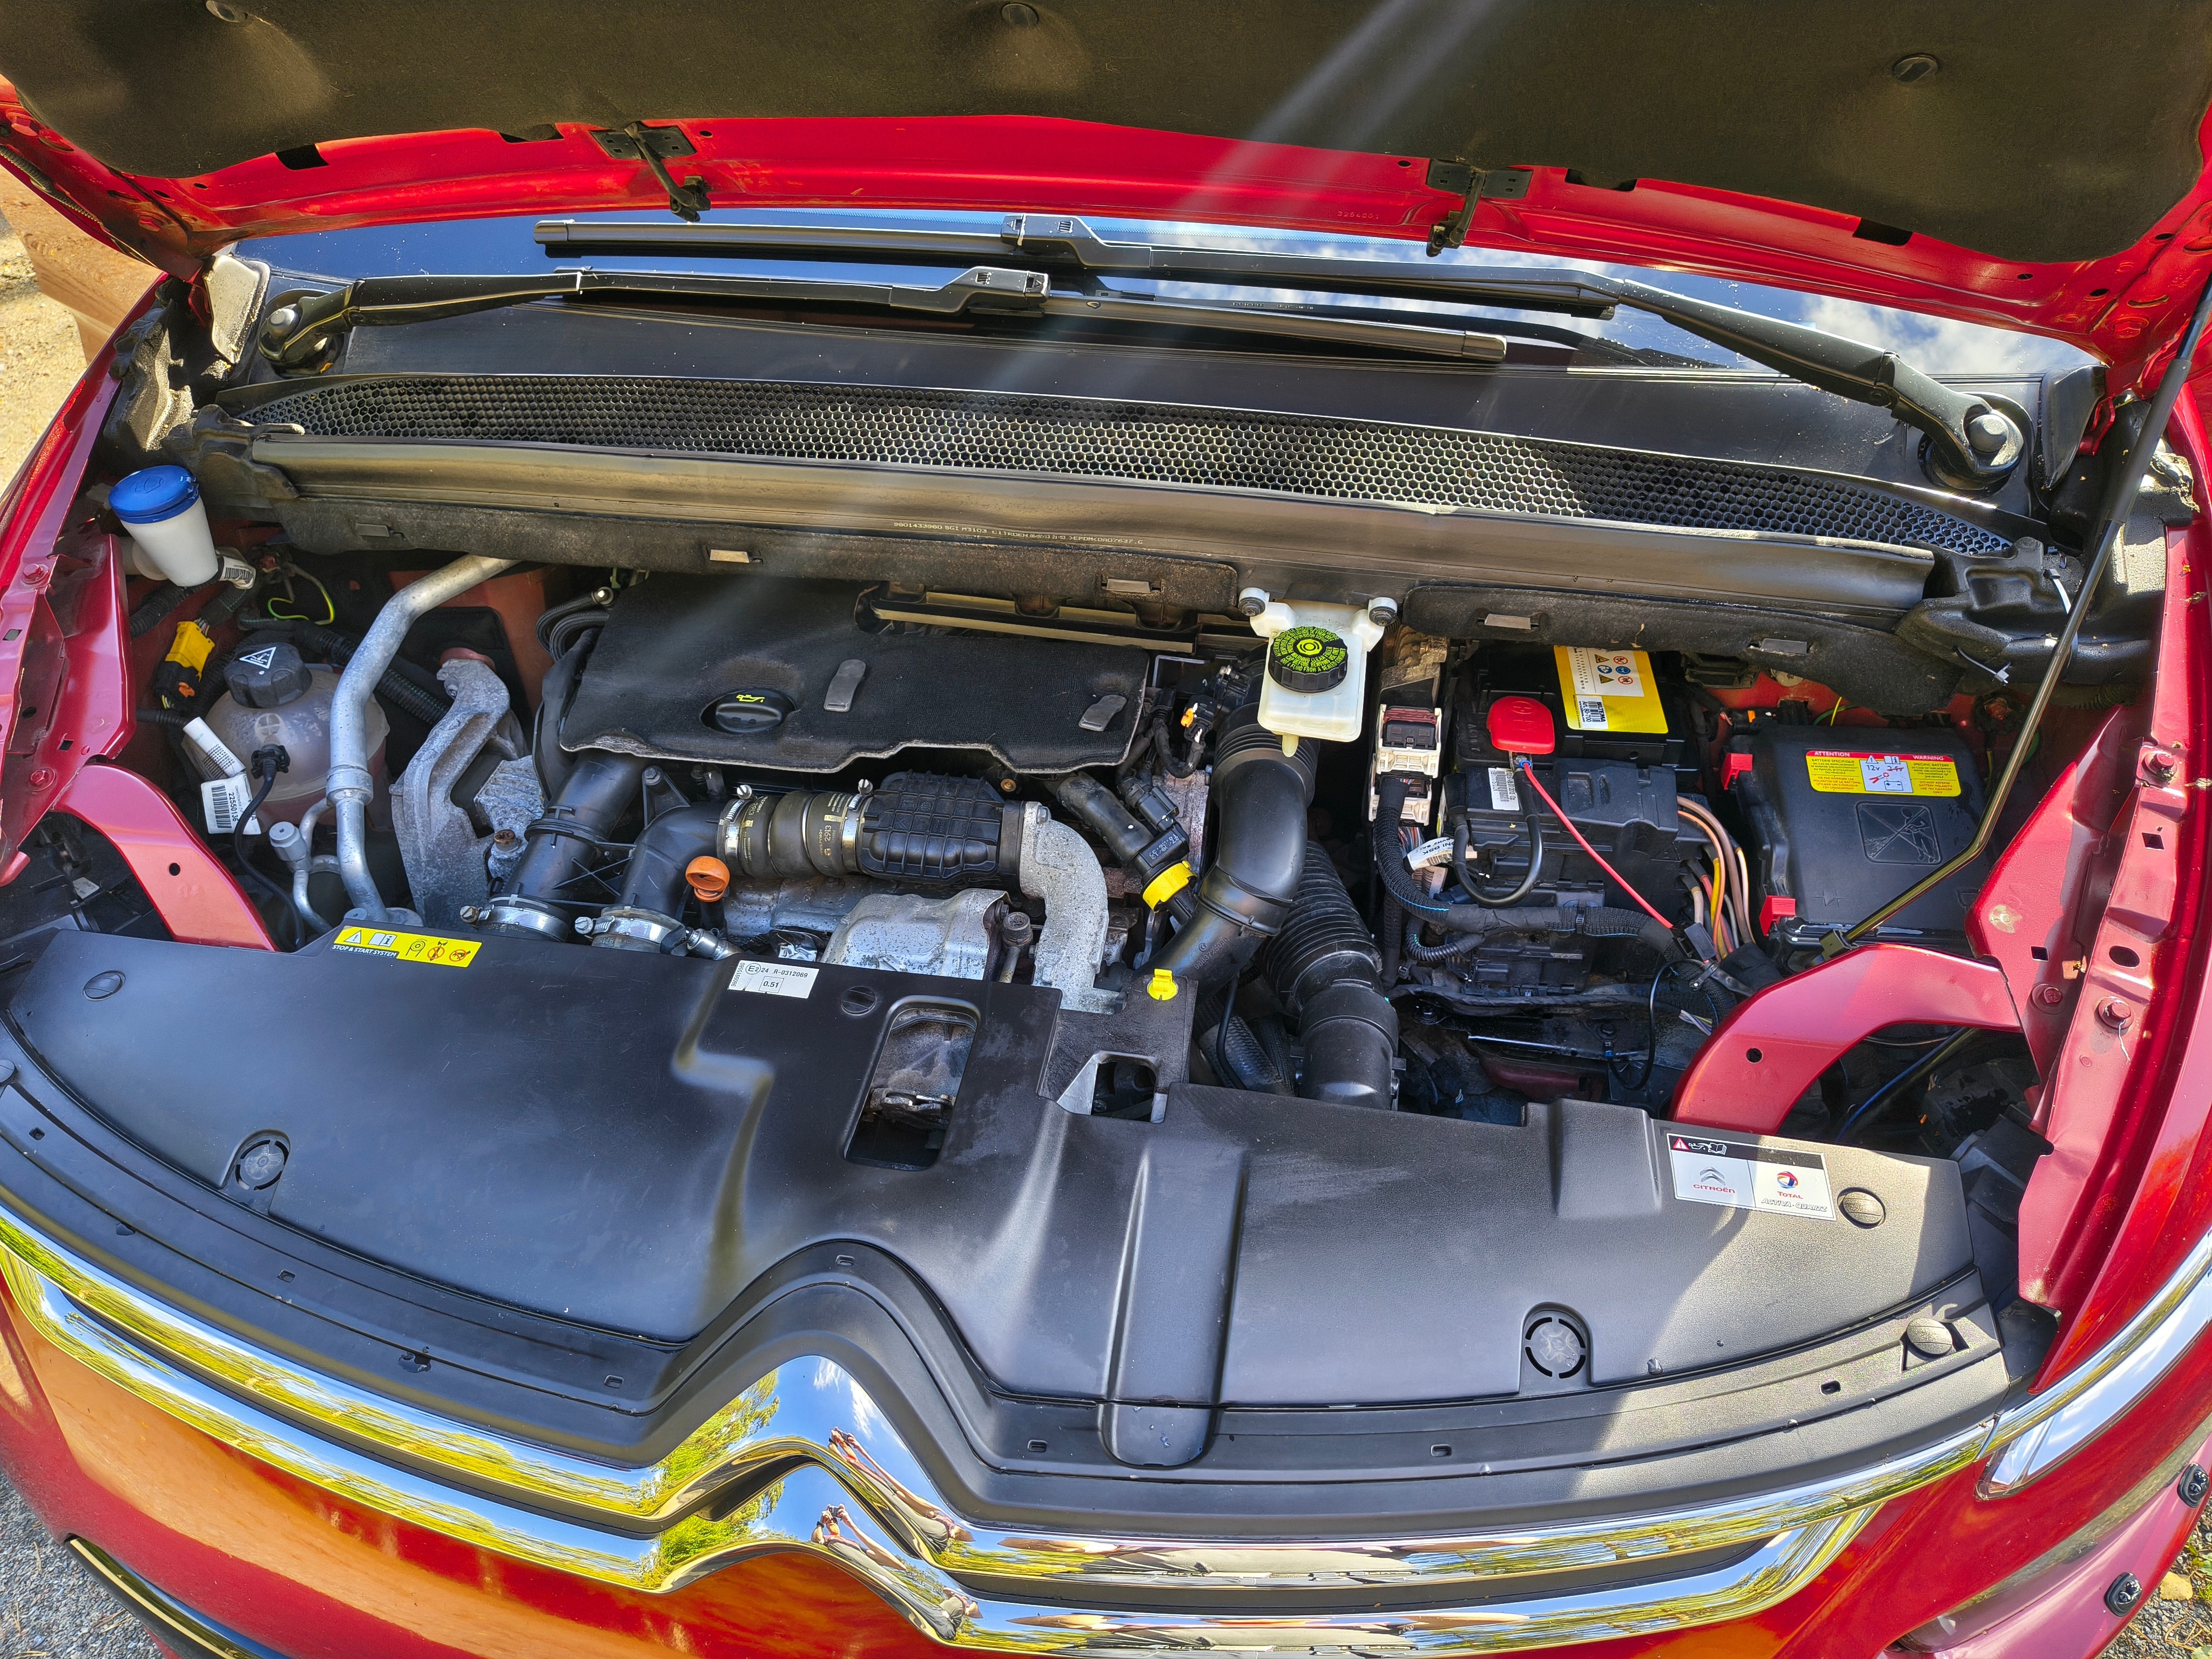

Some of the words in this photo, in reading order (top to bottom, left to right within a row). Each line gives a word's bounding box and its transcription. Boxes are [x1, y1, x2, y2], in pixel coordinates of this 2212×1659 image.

[1292, 659, 1310, 667] BEFORE
[1596, 702, 1606, 722] BILTEMA
[228, 792, 239, 822] 22550136
[1423, 846, 1440, 855] BSK
[373, 949, 397, 957] SYSTEM
[773, 969, 808, 977] R-0312069
[1693, 1184, 1736, 1193] CITROËN
[1777, 1191, 1804, 1199] TOTAL
